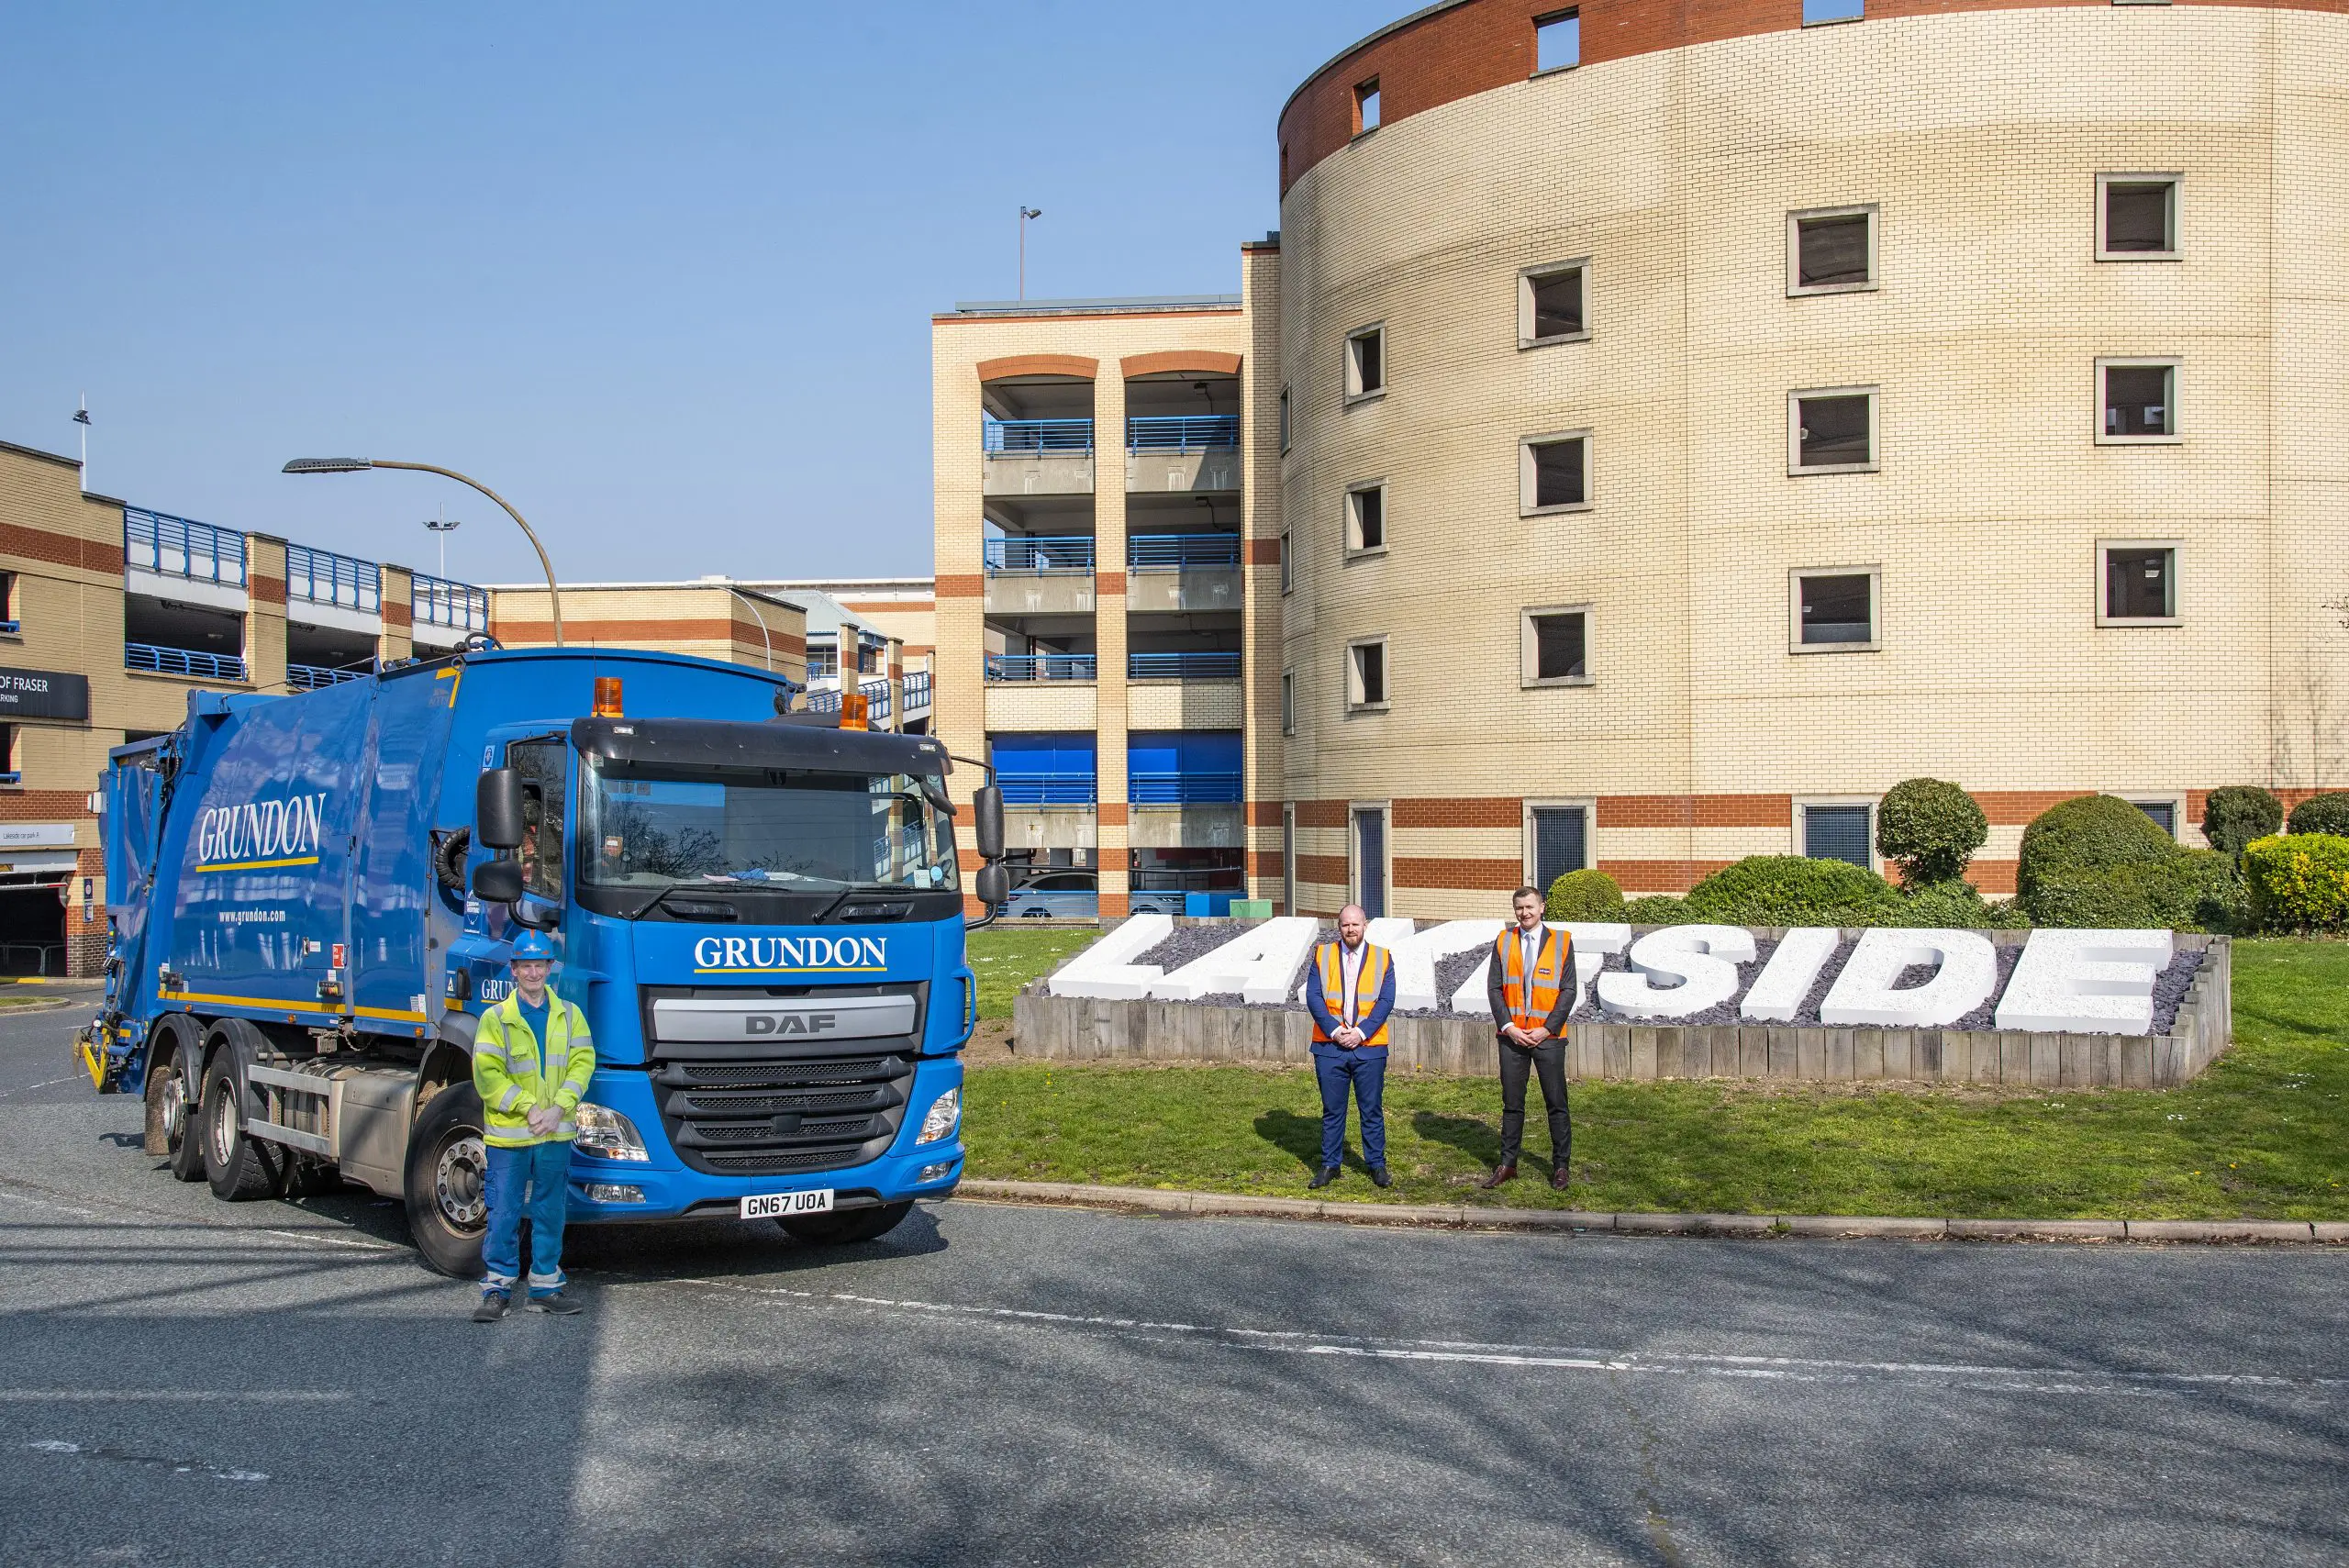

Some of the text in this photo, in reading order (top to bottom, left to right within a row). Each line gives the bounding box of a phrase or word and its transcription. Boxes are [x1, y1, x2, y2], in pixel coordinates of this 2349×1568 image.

[13, 676, 49, 693] FRASER
[0, 694, 18, 703] RKING
[199, 792, 327, 862] GRUNDON
[218, 907, 286, 926] www.grundon.com
[694, 937, 887, 967] GRUNDON
[745, 1014, 836, 1035] DAF
[748, 1192, 826, 1216] GN67 UOA
